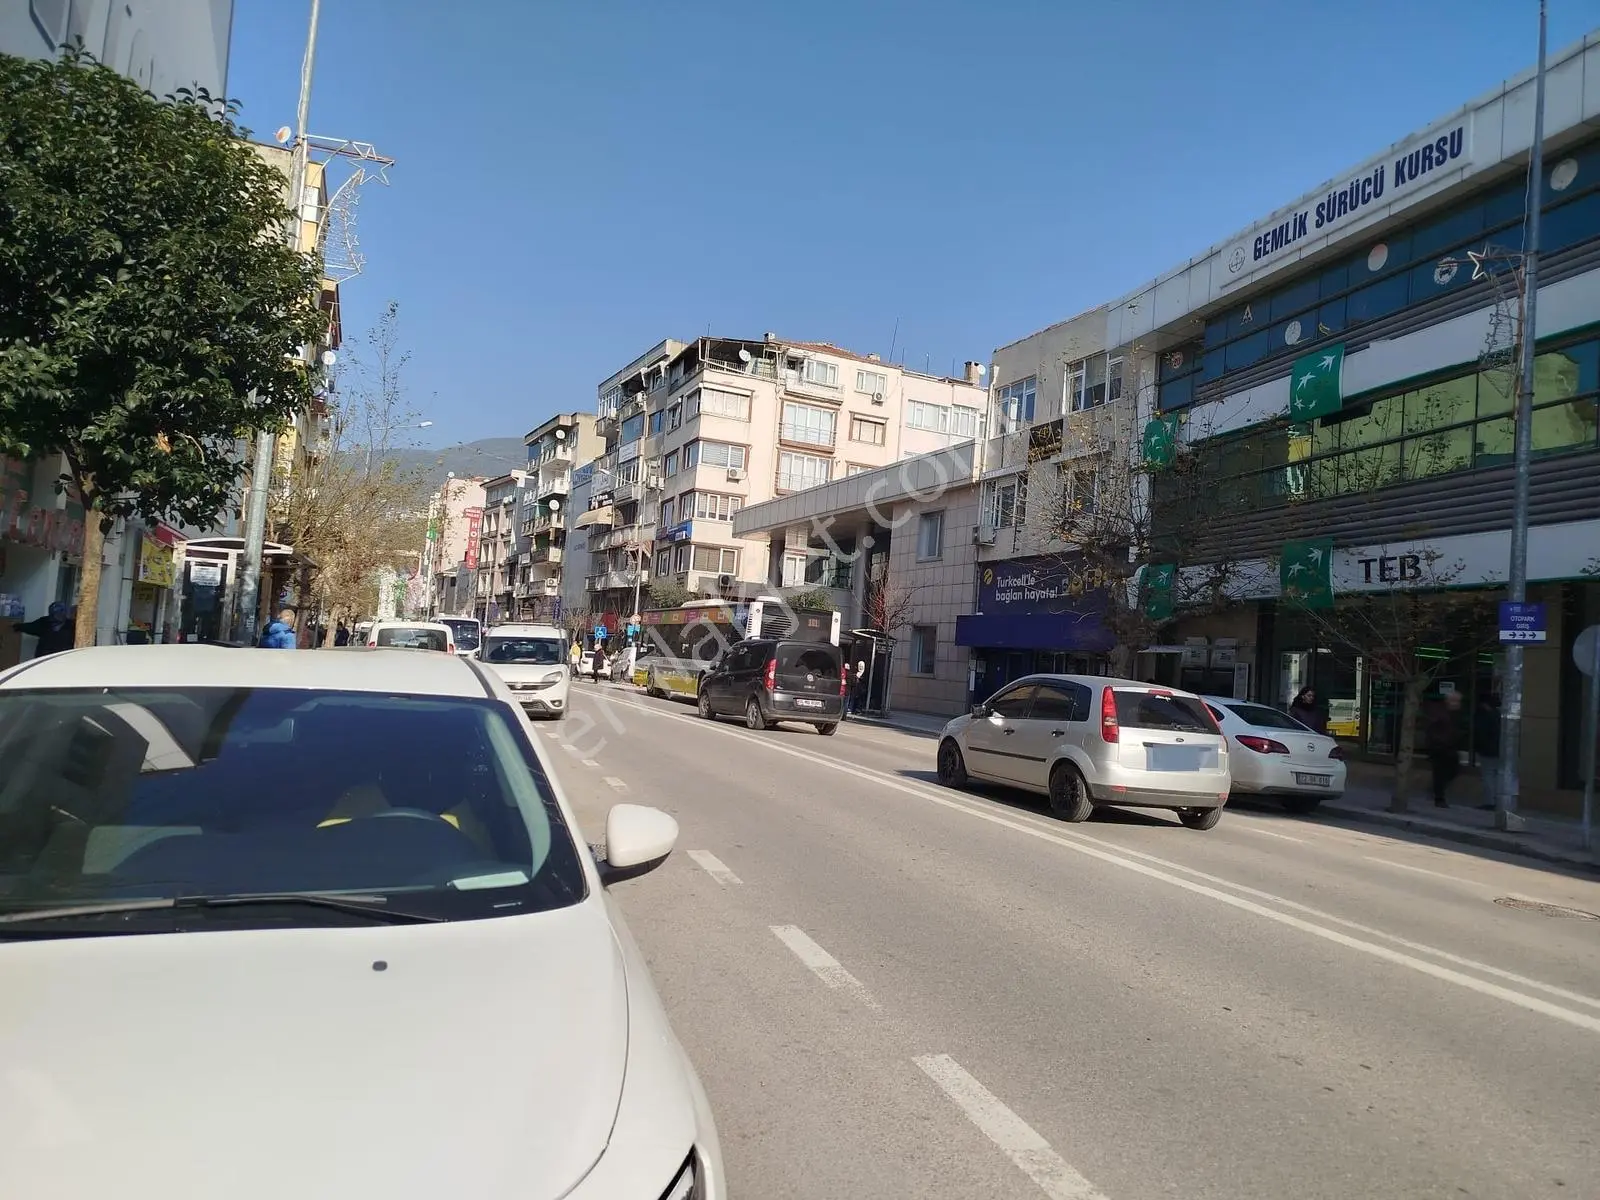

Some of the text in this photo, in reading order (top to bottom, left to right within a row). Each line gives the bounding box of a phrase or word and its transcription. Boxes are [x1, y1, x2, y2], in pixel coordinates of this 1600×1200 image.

[1253, 127, 1463, 261] GEMLİK SÜRÜCÜ KURSU
[467, 520, 478, 569] HOTEL
[1358, 553, 1421, 584] TEB
[995, 586, 1058, 603] bağlan hayata!
